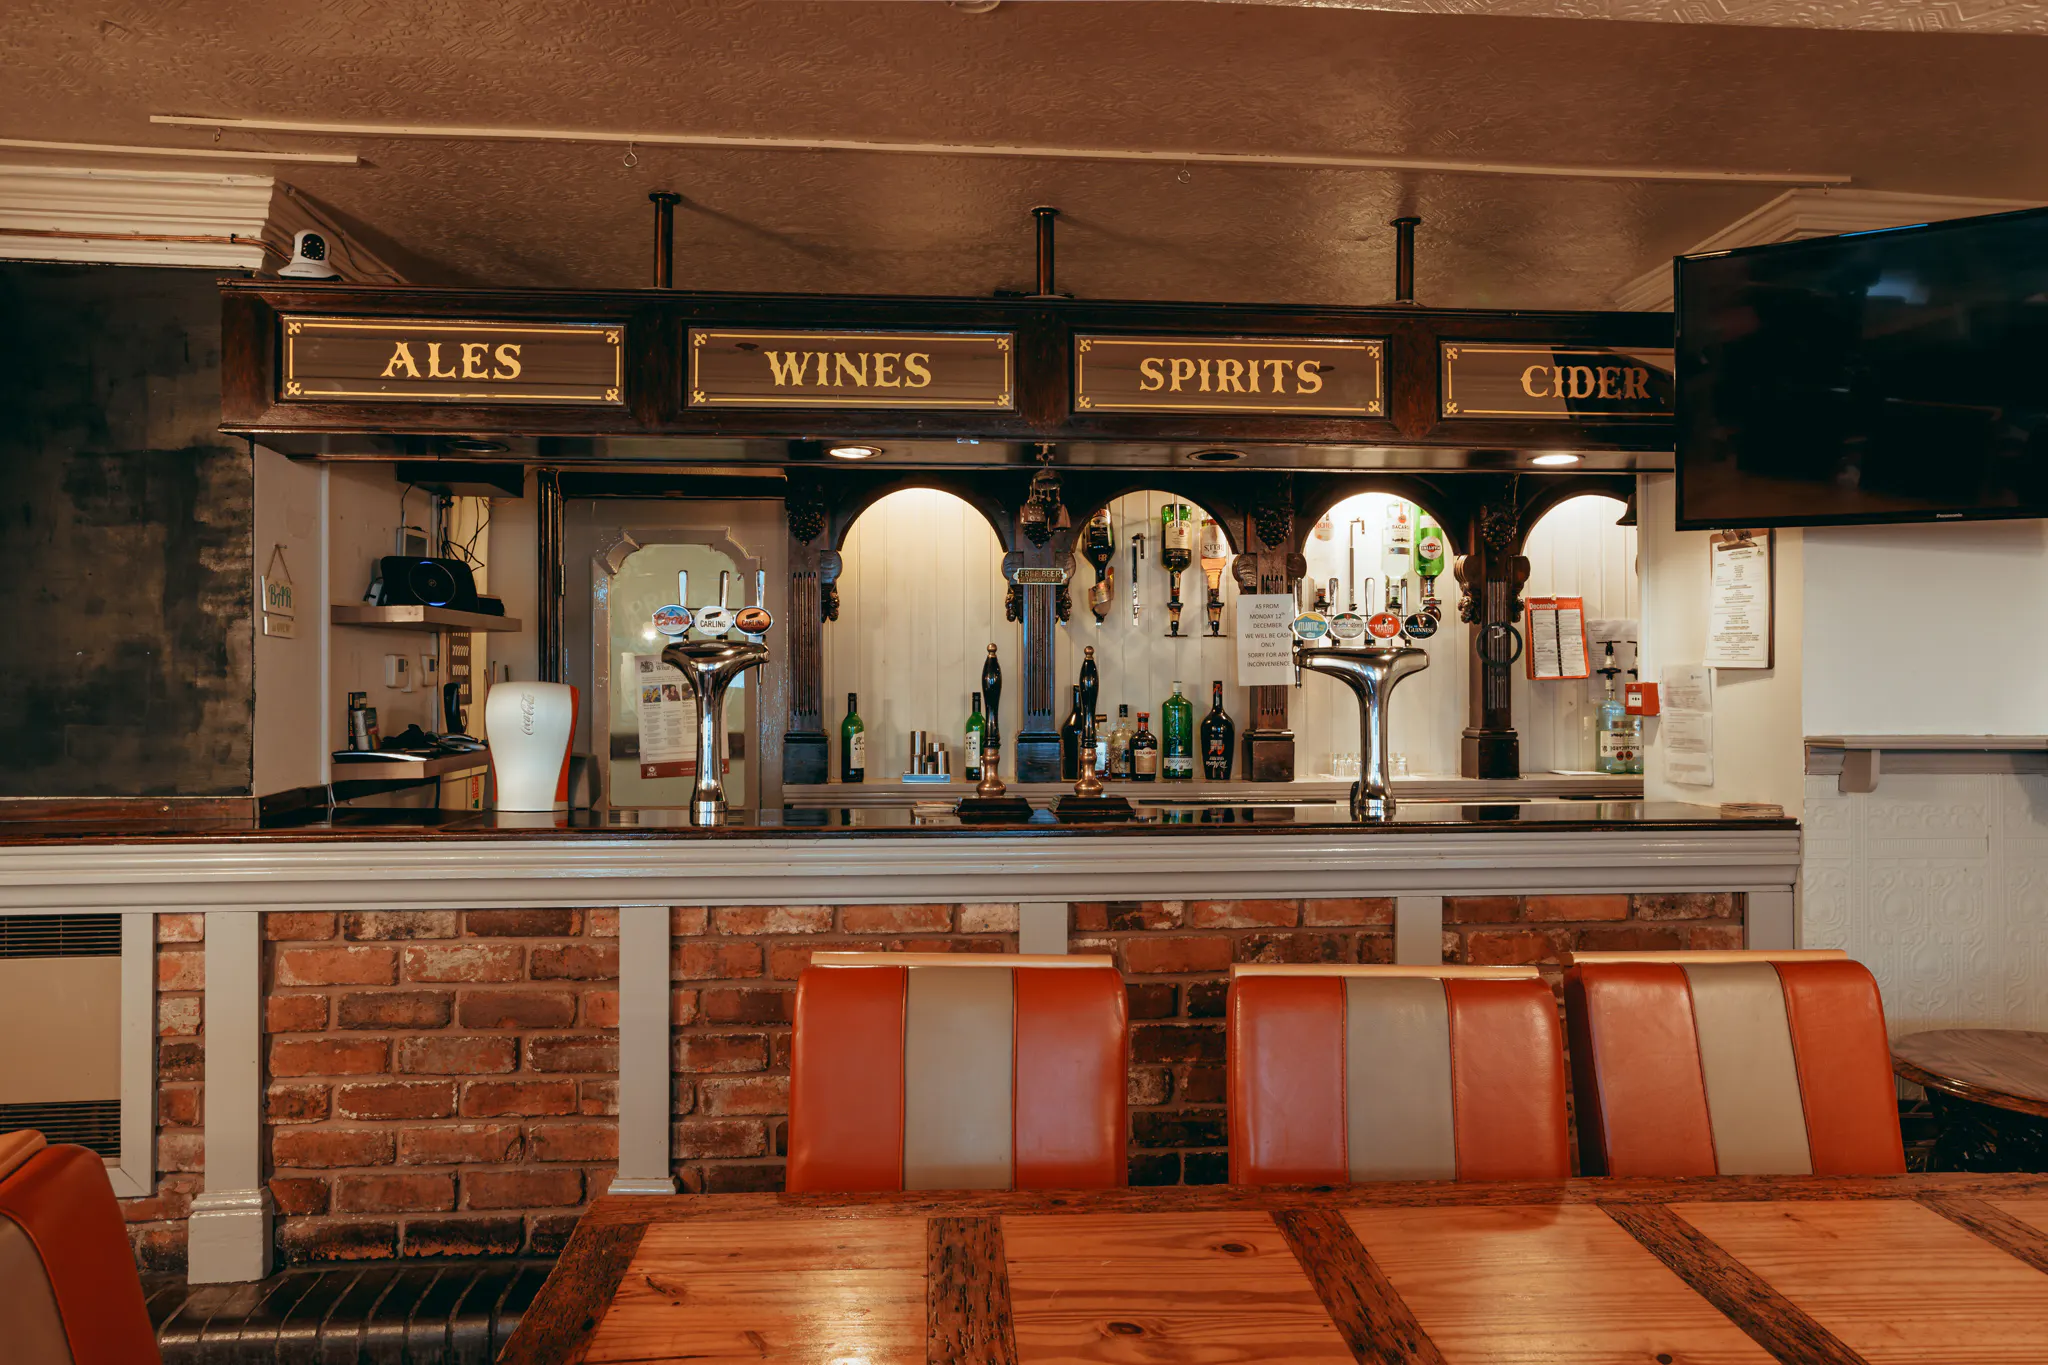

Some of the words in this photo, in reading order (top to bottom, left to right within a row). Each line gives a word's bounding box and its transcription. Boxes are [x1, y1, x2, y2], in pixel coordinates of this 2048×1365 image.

[380, 341, 521, 380] ALES
[764, 350, 932, 388] WINES
[1139, 357, 1323, 394] SPIRITS
[1520, 364, 1651, 400] CIDER
[1041, 570, 1061, 578] BEER
[653, 612, 689, 626] Coors
[700, 620, 726, 628] CARLING
[1246, 660, 1291, 668] INCONVENIENCE
